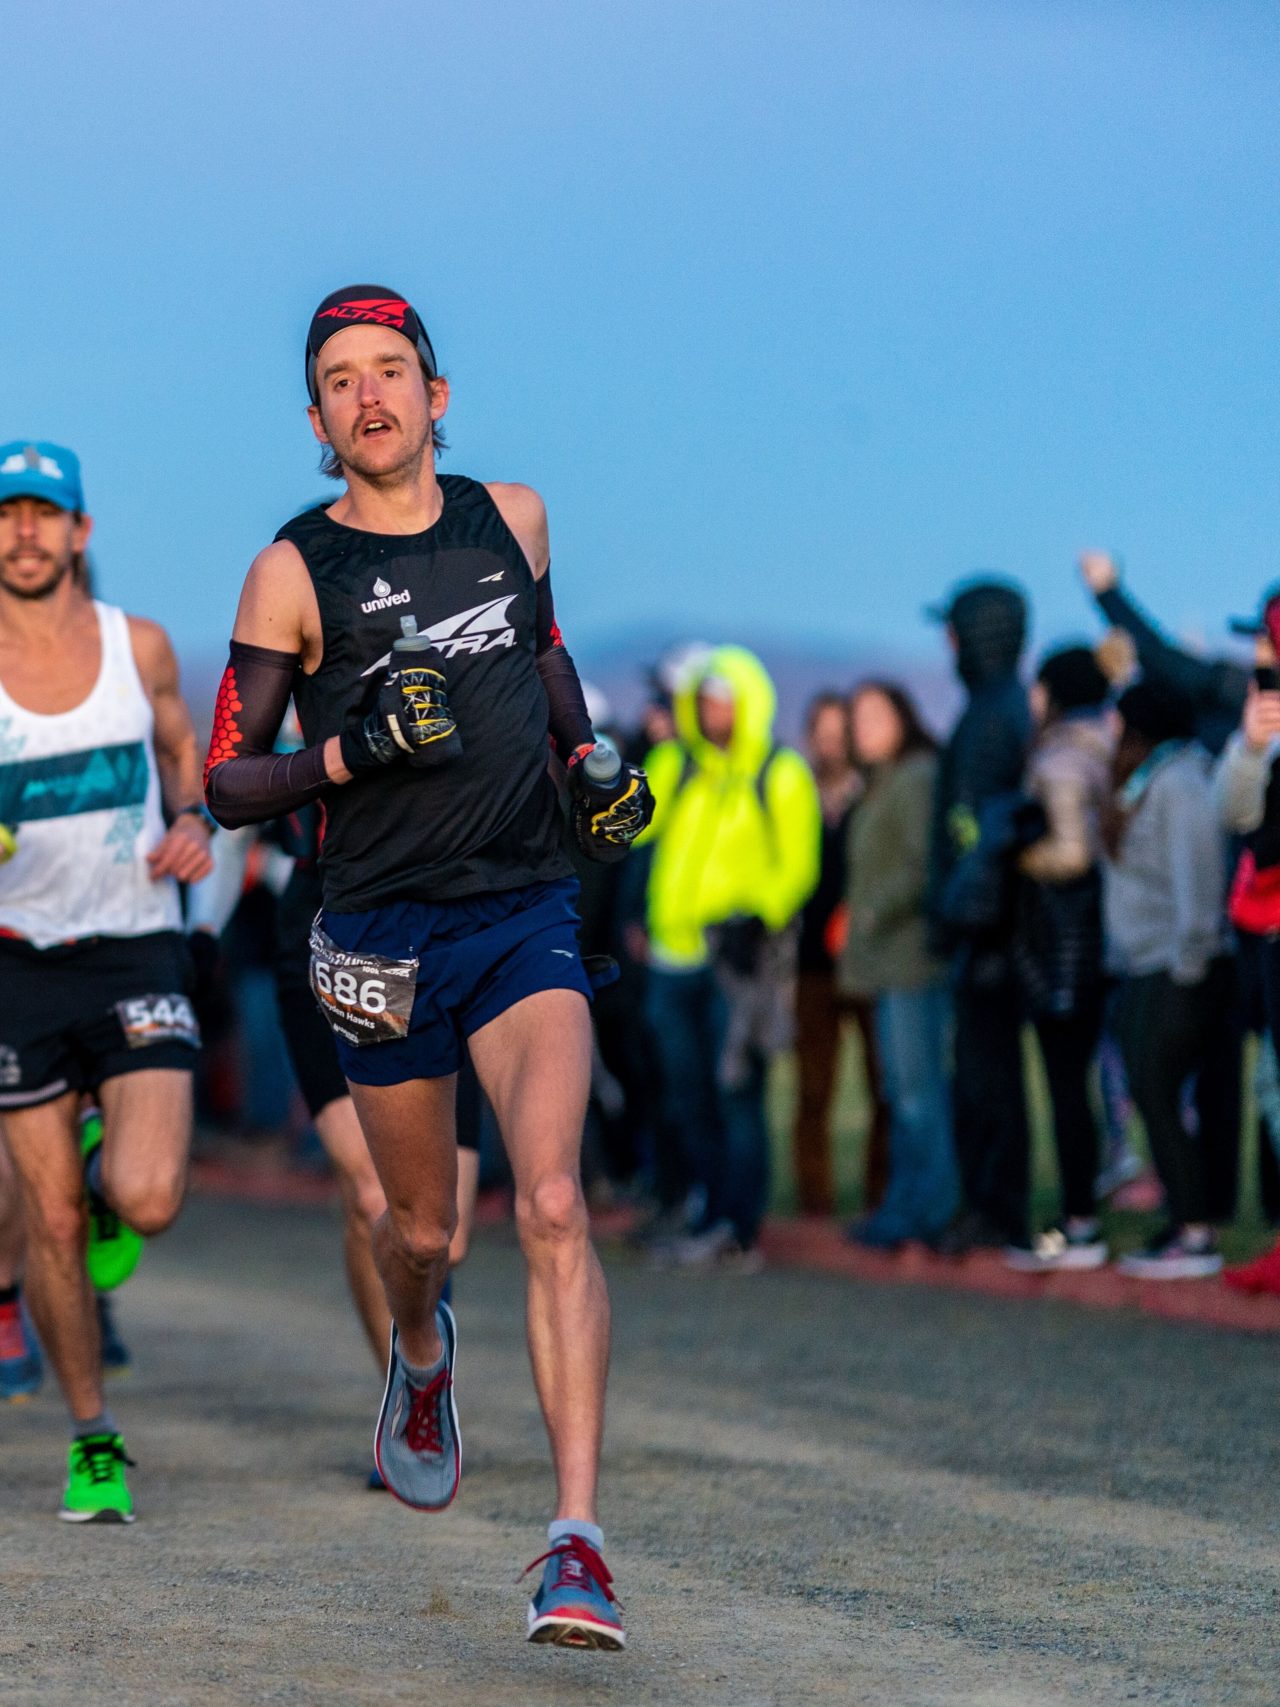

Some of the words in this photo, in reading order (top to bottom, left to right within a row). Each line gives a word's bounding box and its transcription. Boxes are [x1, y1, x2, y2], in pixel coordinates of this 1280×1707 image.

[317, 305, 405, 328] ALTRA
[360, 588, 412, 614] unived
[315, 962, 387, 1014] 686
[126, 999, 194, 1029] 544
[346, 1012, 376, 1030] Hawks
